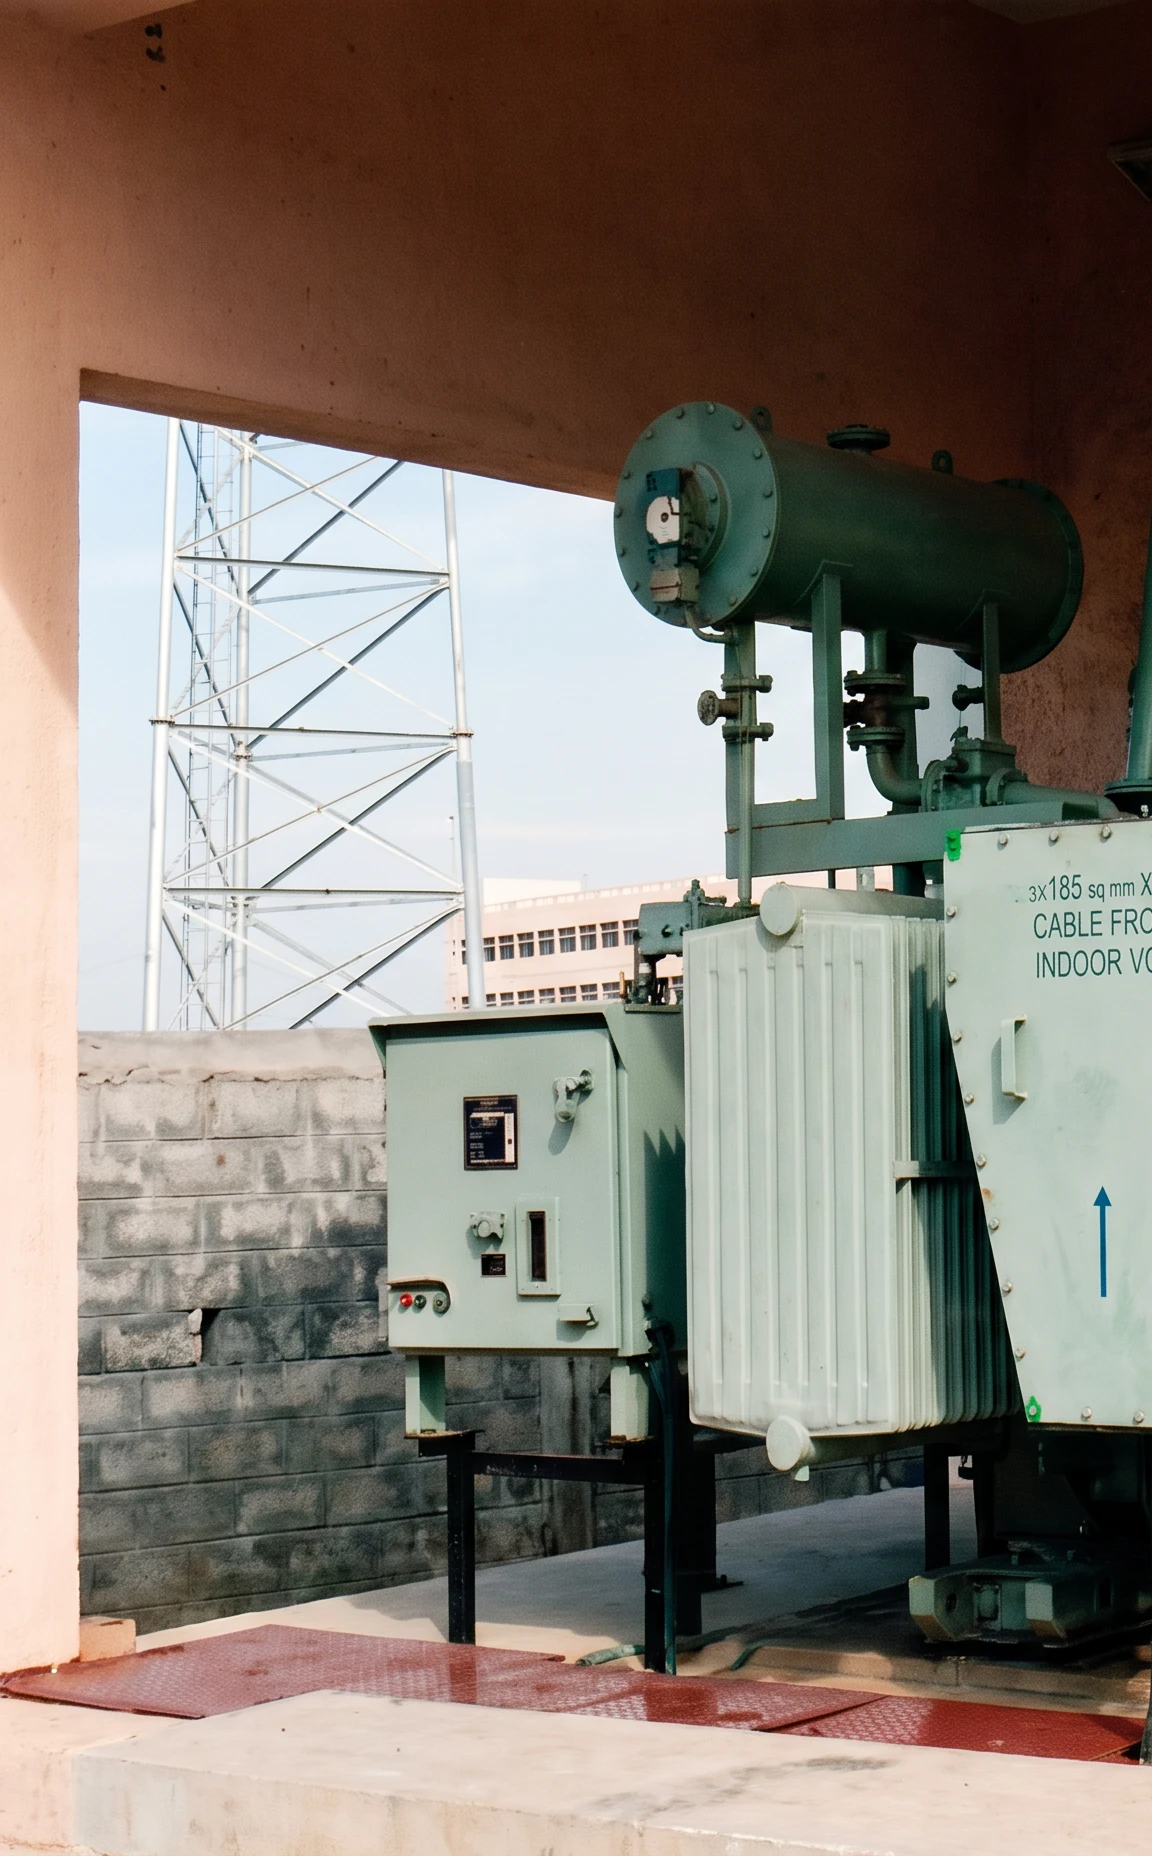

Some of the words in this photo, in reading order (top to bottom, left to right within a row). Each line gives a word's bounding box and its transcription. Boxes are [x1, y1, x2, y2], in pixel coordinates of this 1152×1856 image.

[1088, 883, 1105, 903] sq
[1109, 881, 1135, 898] mm
[1033, 910, 1103, 939] CABLE
[1036, 949, 1122, 978] INDOOR
